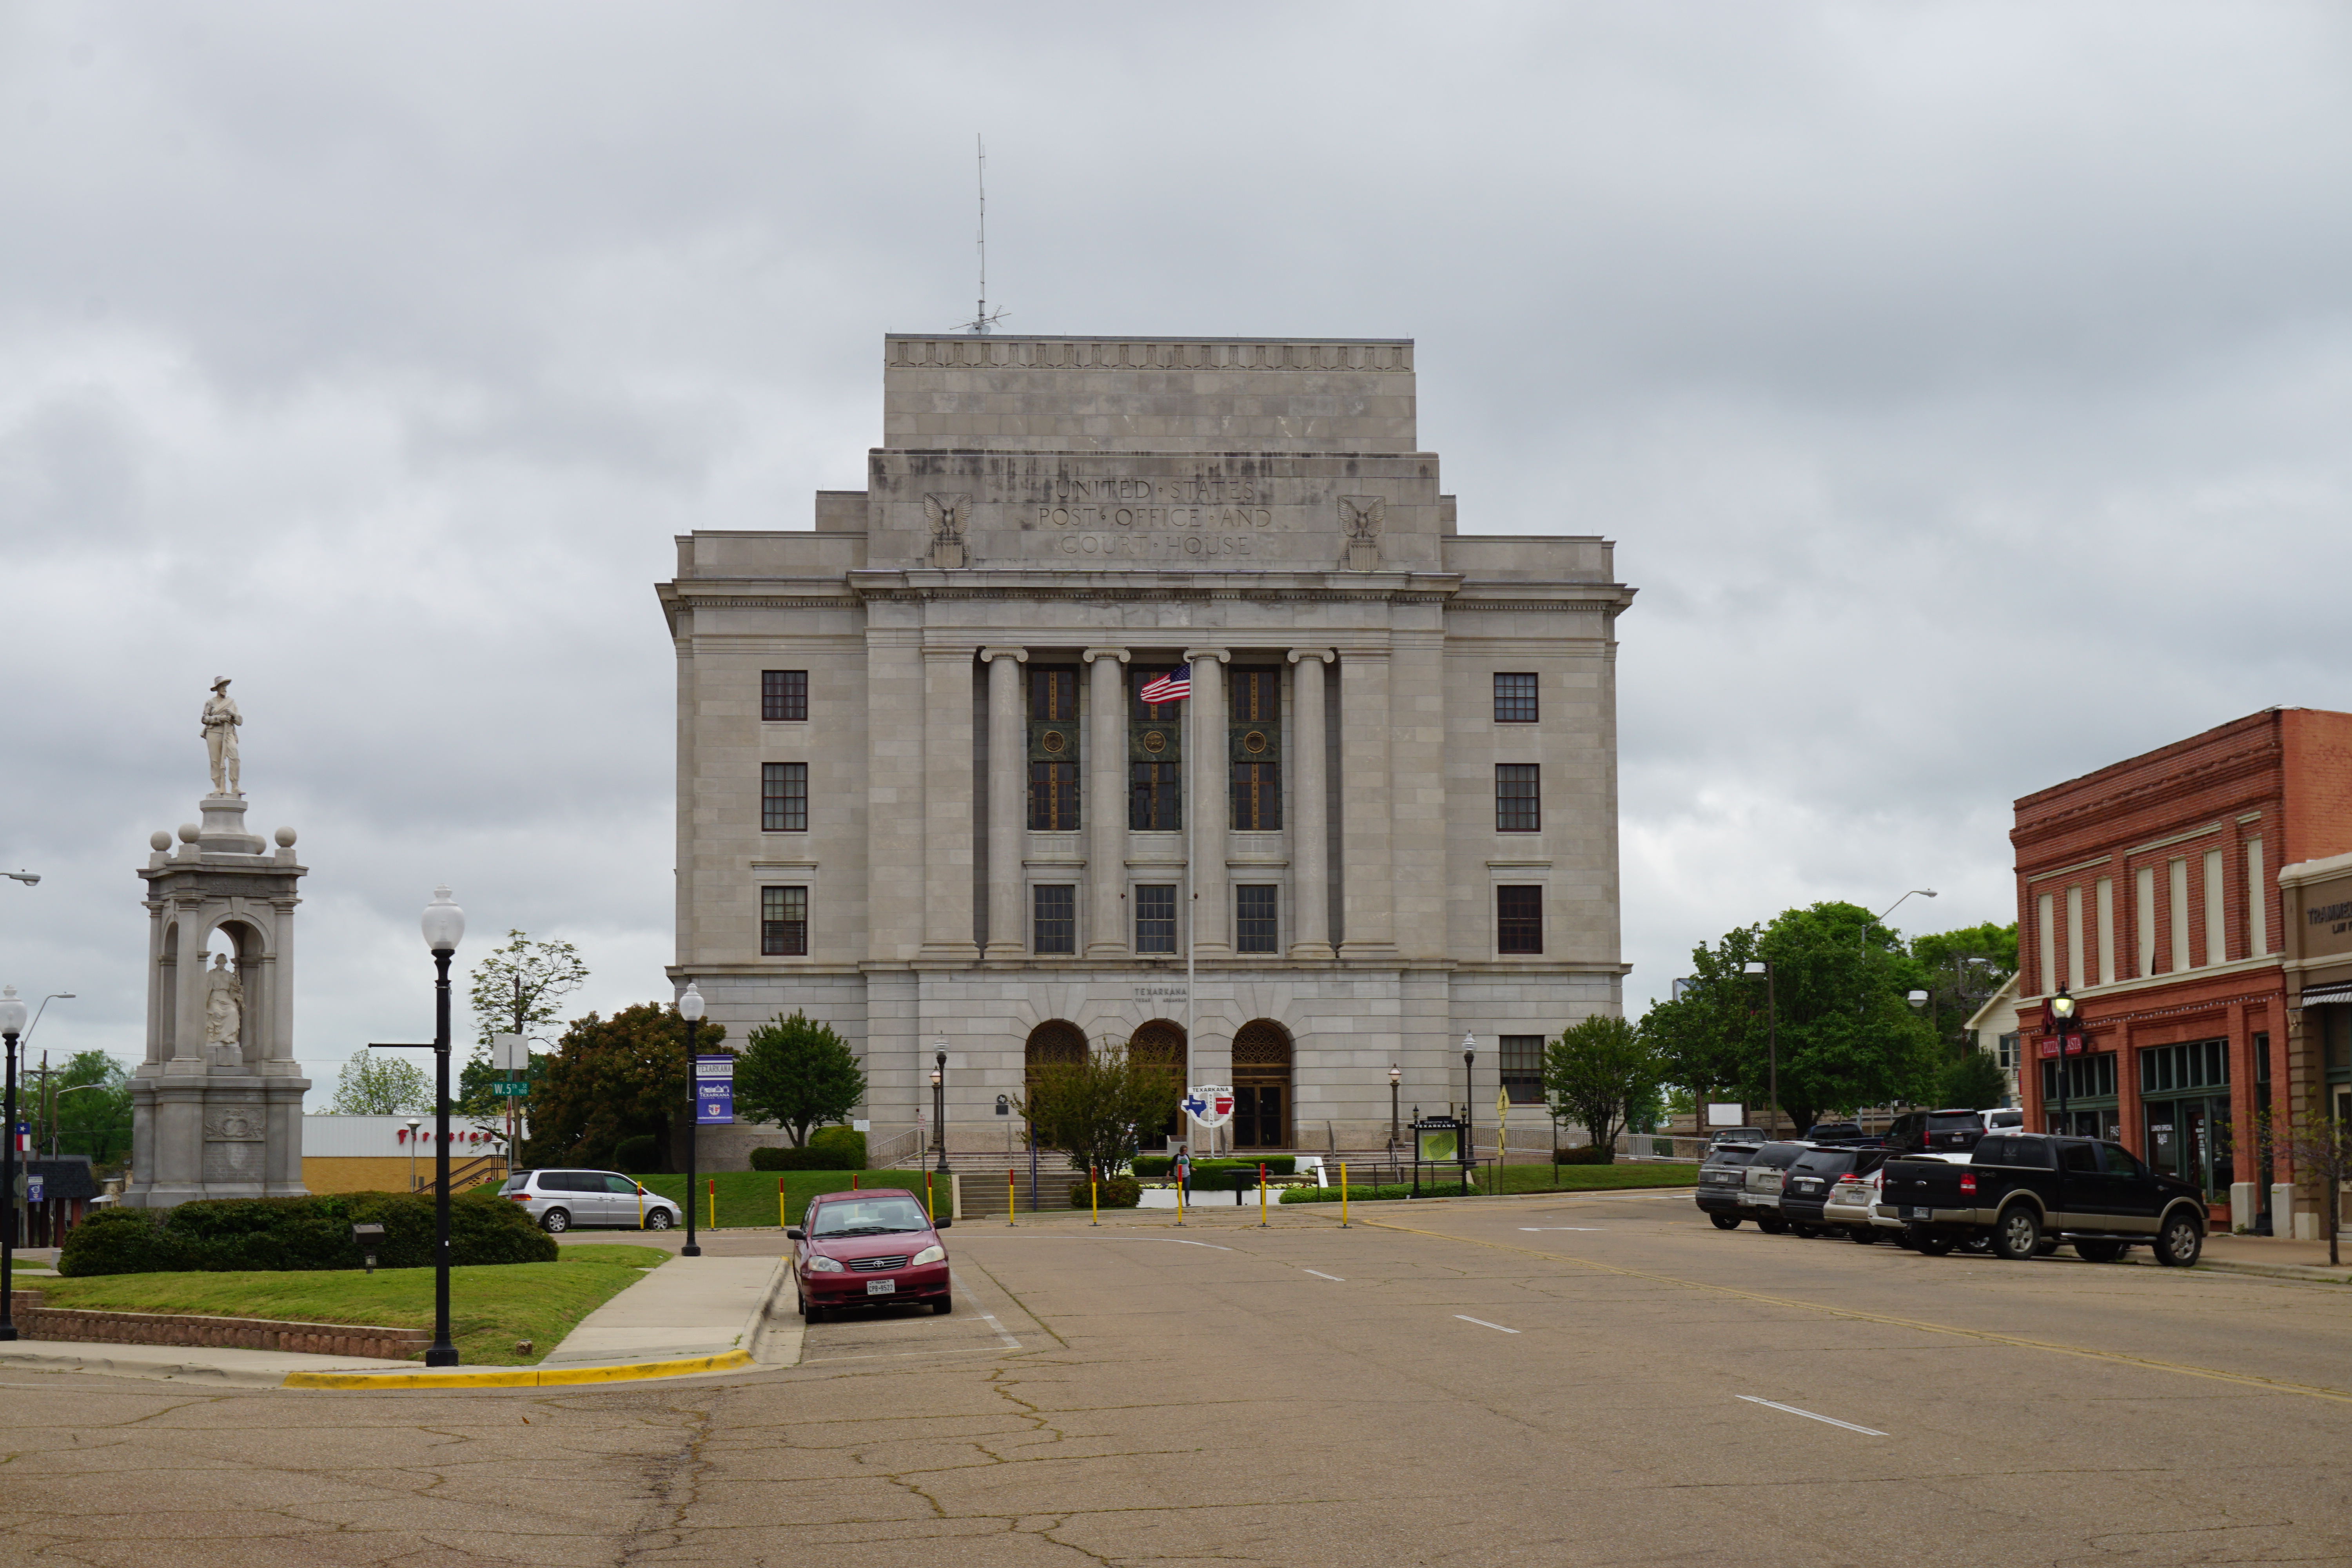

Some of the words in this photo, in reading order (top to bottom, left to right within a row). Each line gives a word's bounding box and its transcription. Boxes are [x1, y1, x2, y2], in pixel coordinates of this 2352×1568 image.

[1056, 480, 1151, 499] UNITED
[1171, 481, 1253, 499] STATES
[1038, 508, 1096, 526] POST
[1115, 508, 1201, 527] OFFICE
[1220, 509, 1271, 527] AND
[1061, 536, 1147, 554] COURT
[1166, 537, 1250, 555] HOUSE
[2065, 1038, 2082, 1051] ASTA
